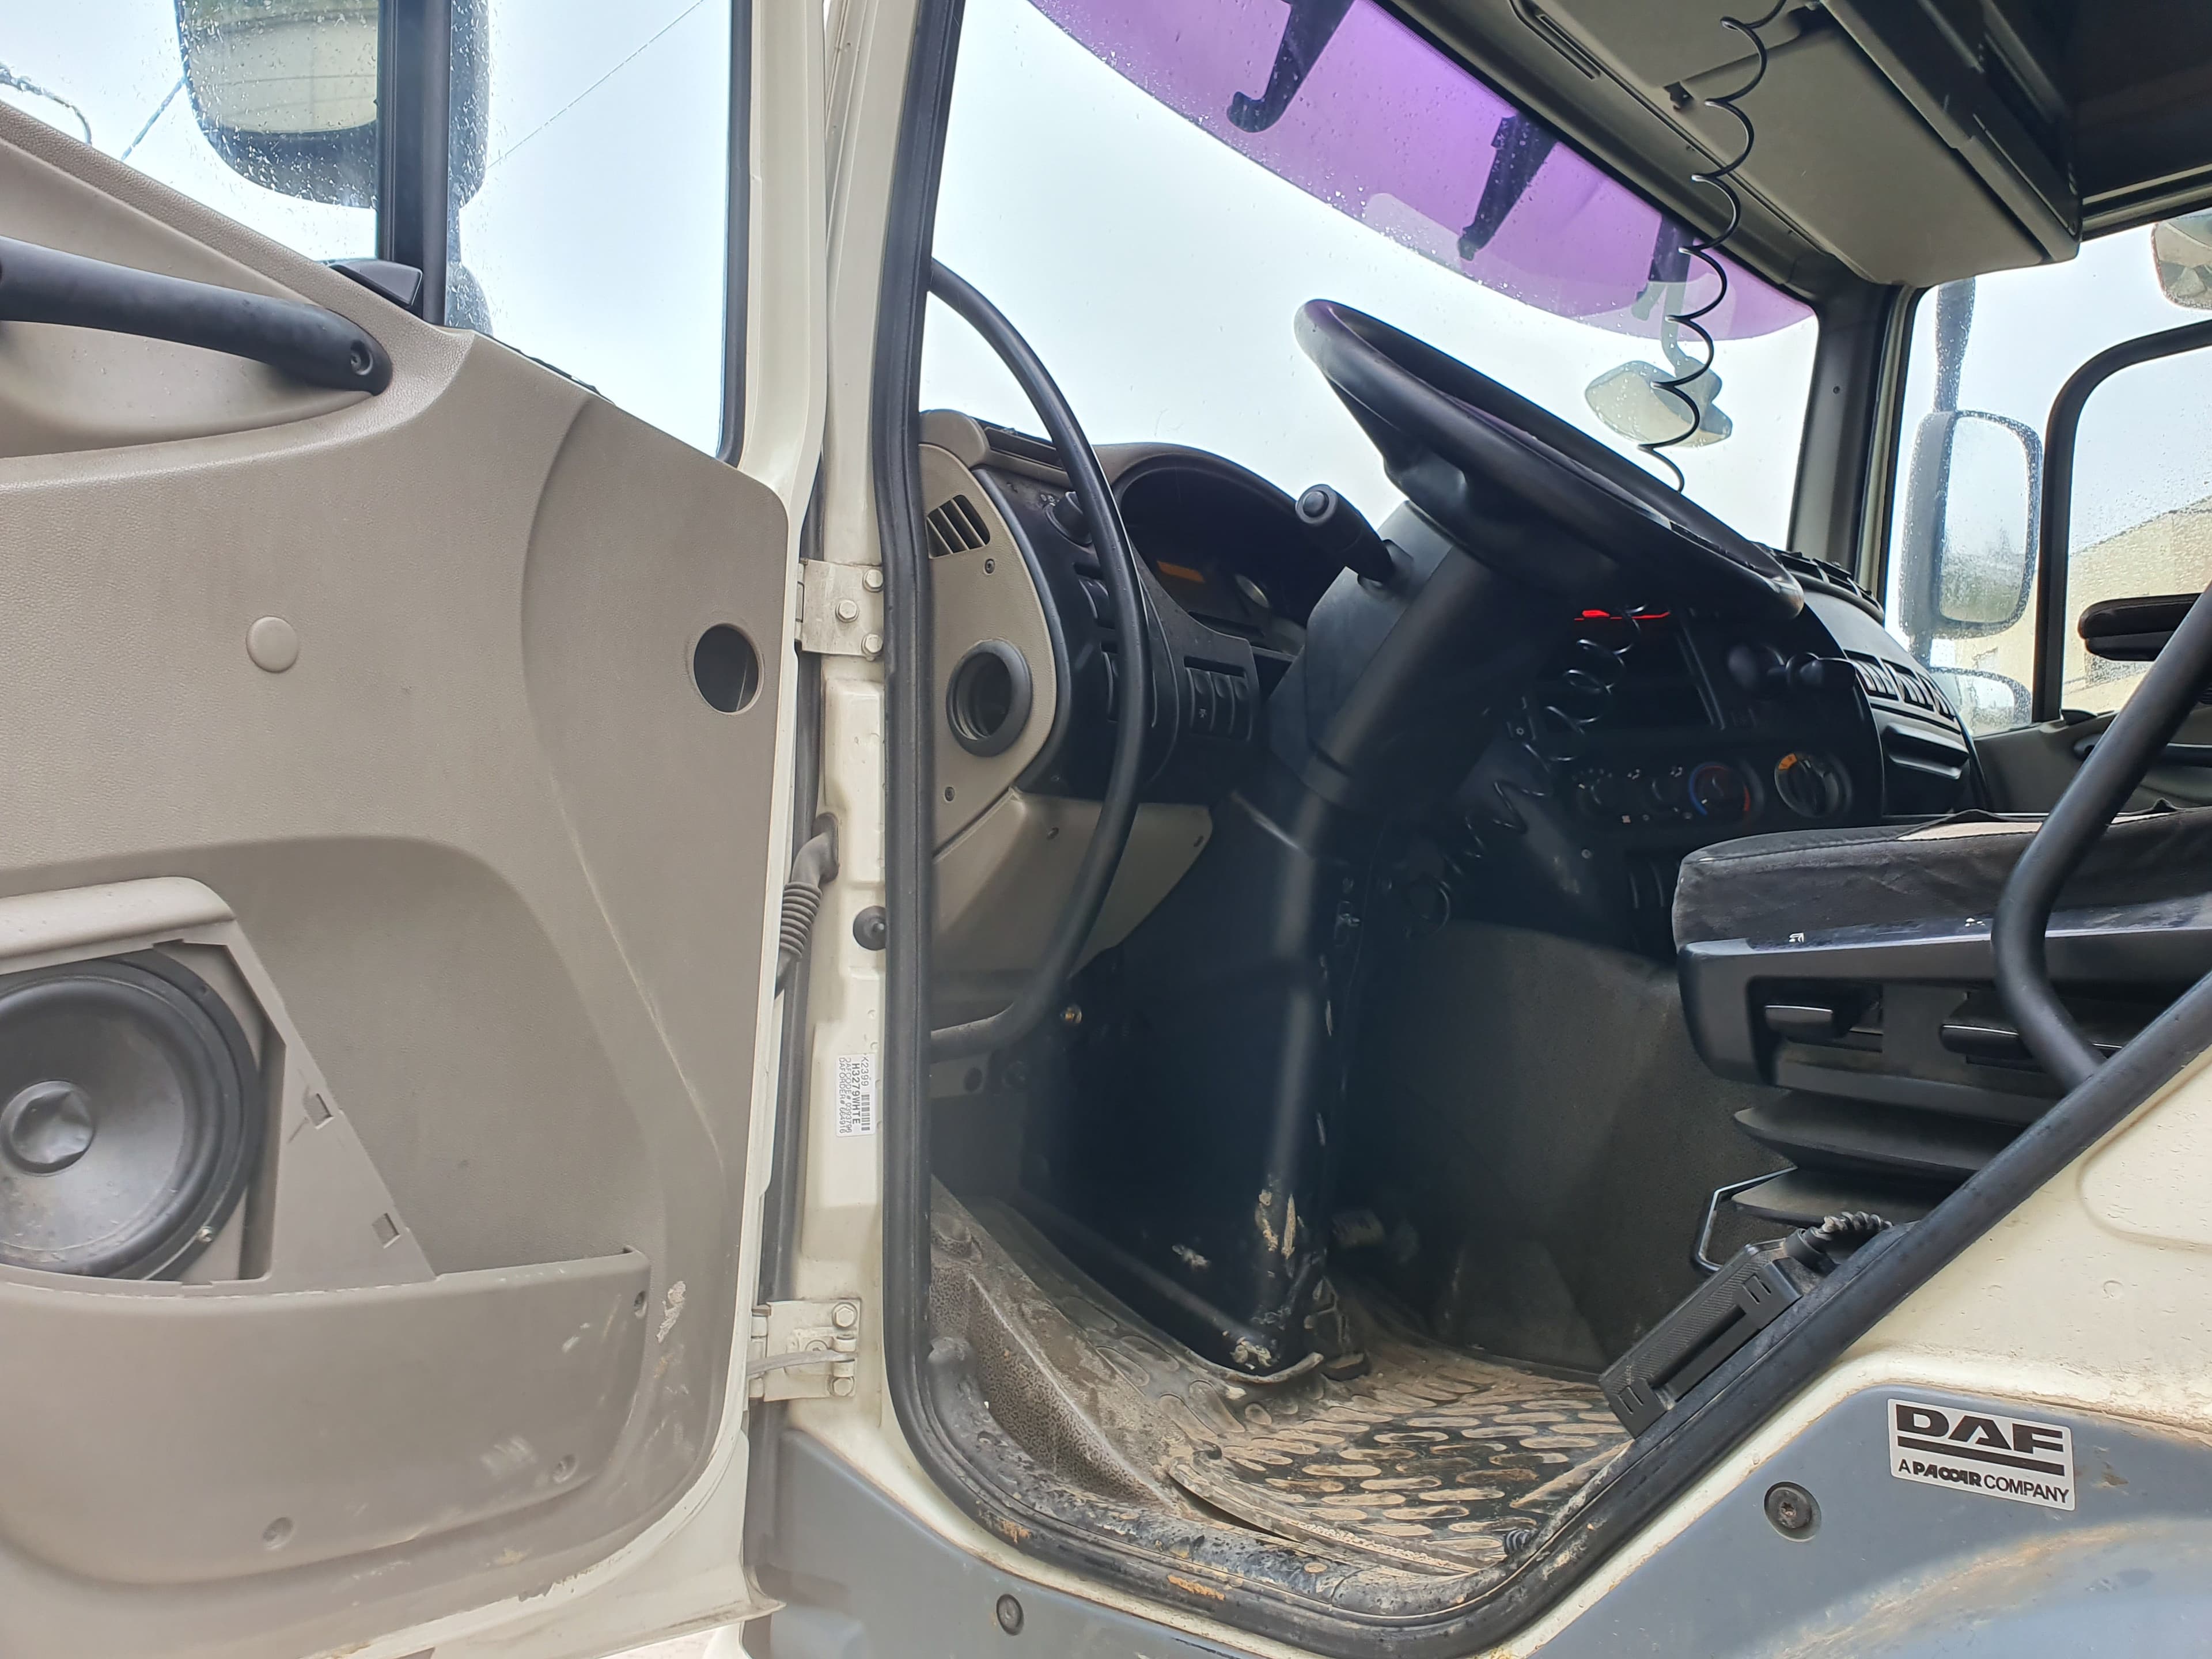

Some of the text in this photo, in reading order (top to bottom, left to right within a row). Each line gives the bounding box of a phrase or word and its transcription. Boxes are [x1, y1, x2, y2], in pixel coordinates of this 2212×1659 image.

[851, 1063, 861, 1124] H3279WHTE
[1895, 1404, 2064, 1455] DAF
[1898, 1459, 2070, 1503] A PACCAR COMPANY
